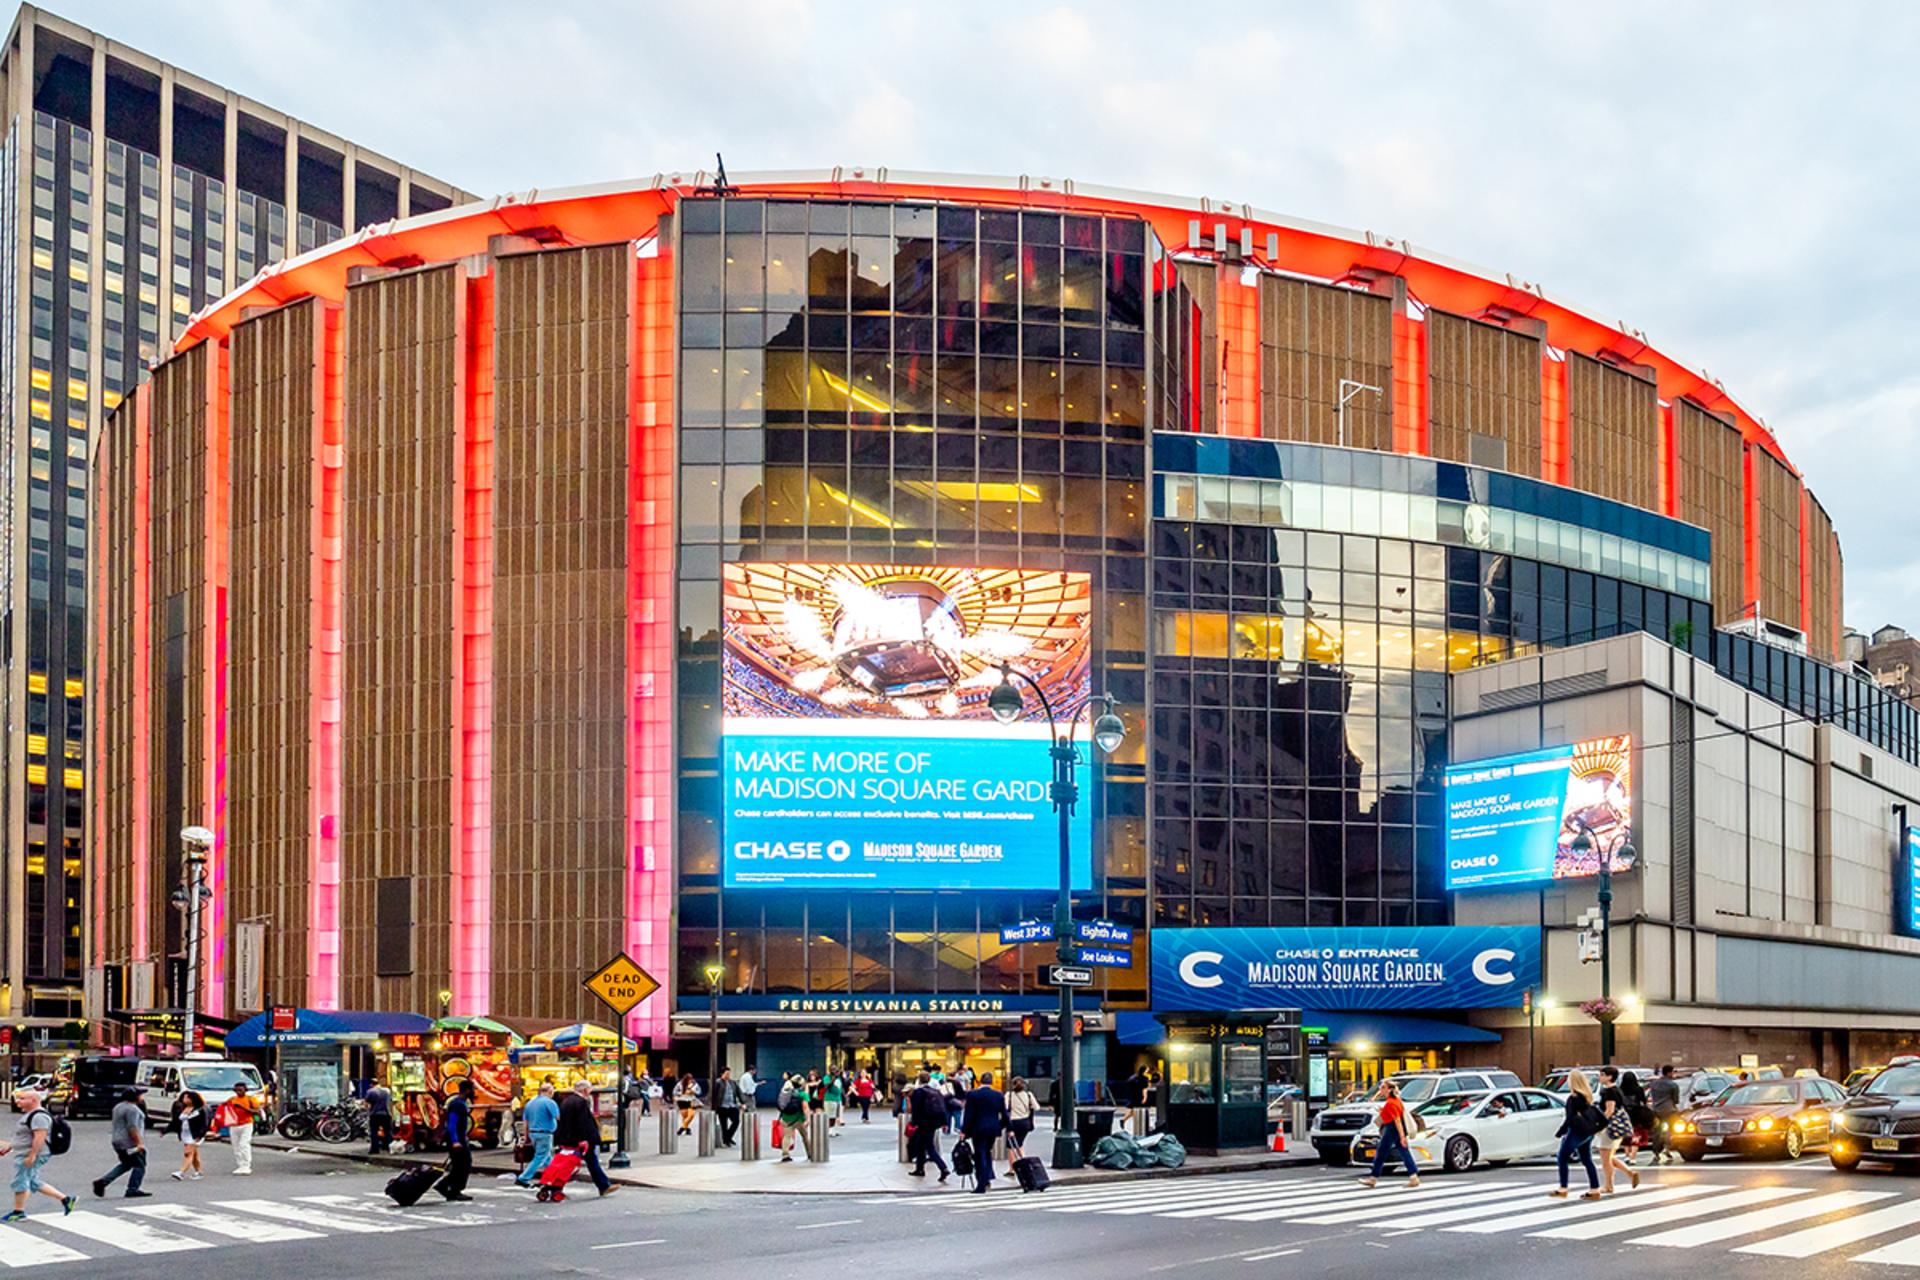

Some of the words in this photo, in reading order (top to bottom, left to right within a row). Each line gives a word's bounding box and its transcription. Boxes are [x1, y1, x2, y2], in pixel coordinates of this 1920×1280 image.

[735, 751, 806, 773] MAKE
[813, 751, 889, 774] MORE
[895, 752, 931, 774] OF
[735, 777, 856, 800] MADISON
[863, 778, 967, 804] SQUARE
[973, 780, 1053, 802] GARD
[1451, 800, 1472, 809] MAKE
[1474, 796, 1497, 805] MORE
[1499, 793, 1511, 802] OF
[1451, 808, 1488, 819] MADISON
[1490, 802, 1522, 814] SQUARE
[1523, 796, 1558, 809] GARDEN
[734, 841, 823, 860] CHASE
[863, 841, 913, 858] MADISON
[915, 841, 957, 859] SQUARE
[959, 842, 1002, 858] GARDEN
[1451, 856, 1487, 869] CHASE
[1004, 929, 1025, 940] West
[1042, 925, 1051, 937] St
[1081, 925, 1110, 940] Eighth
[1111, 929, 1128, 940] Ave
[1081, 951, 1094, 962] Joe
[1096, 952, 1115, 963] Louis
[1275, 949, 1320, 959] CHASE
[1338, 948, 1420, 959] ENTRANCE
[1179, 951, 1224, 988] C
[1248, 961, 1317, 983] MADISON
[1322, 961, 1380, 984] SQUARE
[1385, 960, 1443, 982] GARDEN
[1471, 948, 1516, 985] C
[603, 973, 641, 984] DEAD
[608, 987, 636, 998] END
[779, 999, 921, 1011] PENNSYLVANIA
[928, 999, 1003, 1011] STATION
